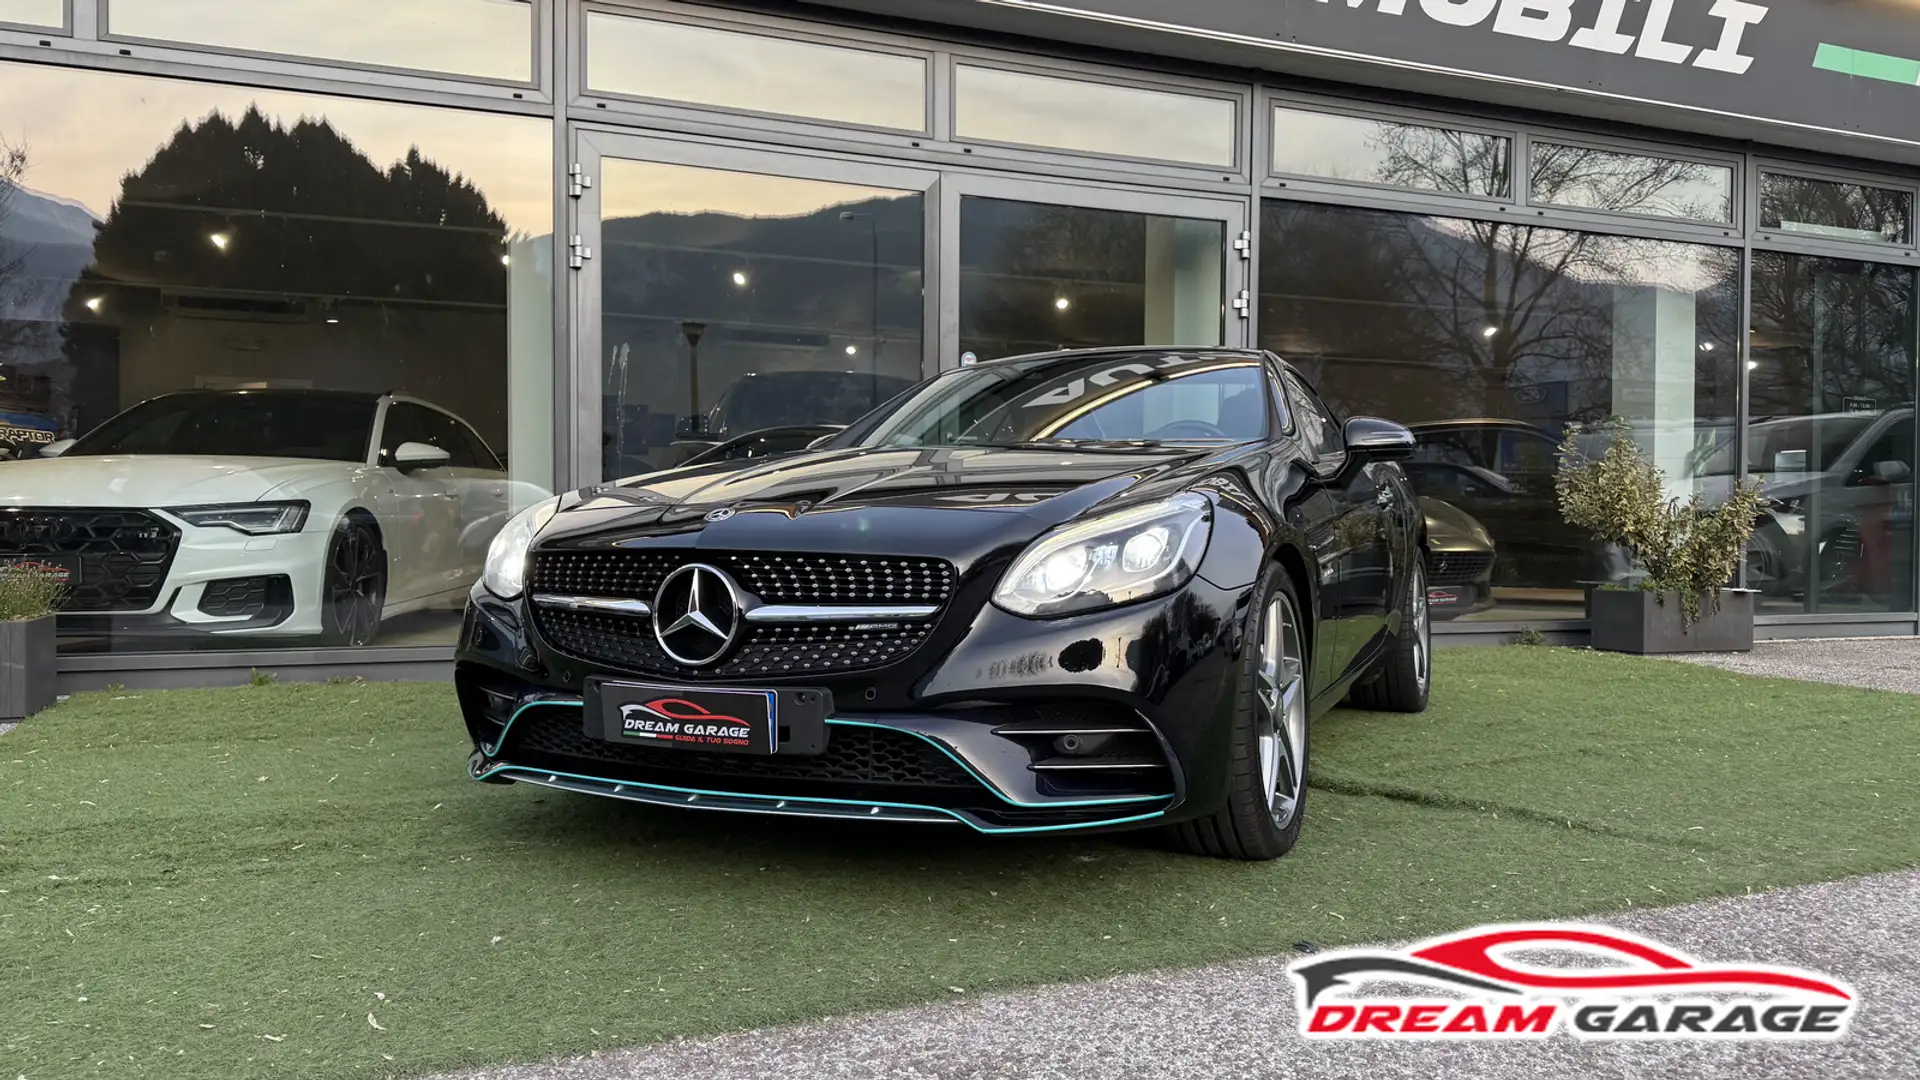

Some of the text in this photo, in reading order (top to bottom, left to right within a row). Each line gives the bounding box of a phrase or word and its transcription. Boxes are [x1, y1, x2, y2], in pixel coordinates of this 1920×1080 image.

[1317, 0, 1769, 75] BILI
[0, 427, 55, 445] RAPTOR
[624, 719, 750, 738] DREAM GARAGE
[675, 735, 696, 743] GUIDA
[723, 738, 749, 746] SOGNO
